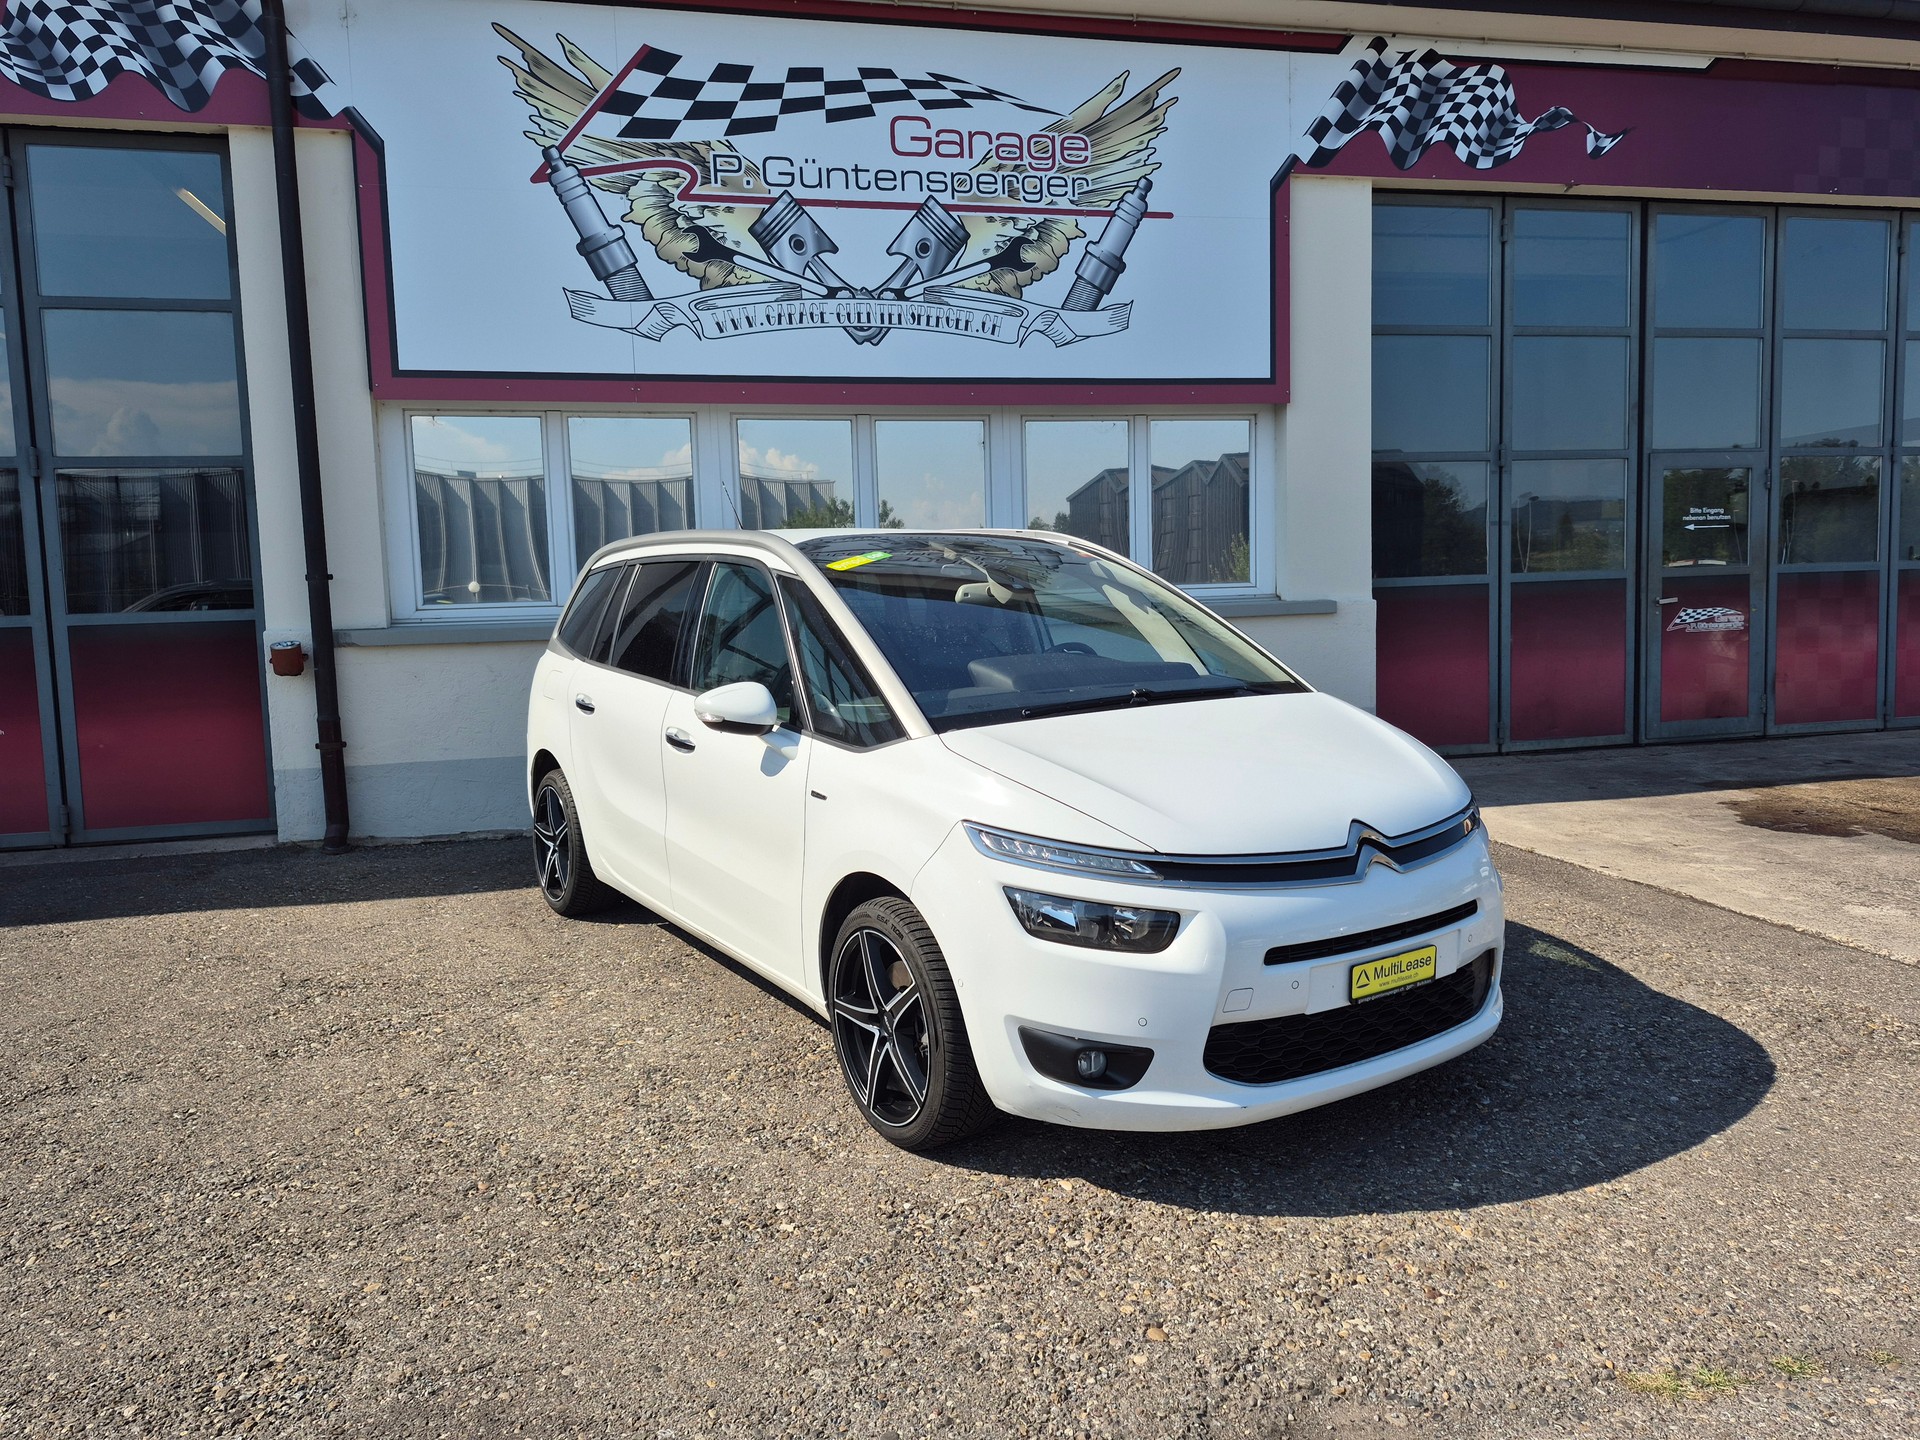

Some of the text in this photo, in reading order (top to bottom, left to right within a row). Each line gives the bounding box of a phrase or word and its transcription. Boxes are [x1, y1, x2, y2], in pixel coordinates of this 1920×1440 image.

[889, 115, 1089, 172] Garage
[711, 302, 1004, 338] WWW.GARAGE-GUENTENSPERGER.CH
[1373, 955, 1432, 980] MultiLease
